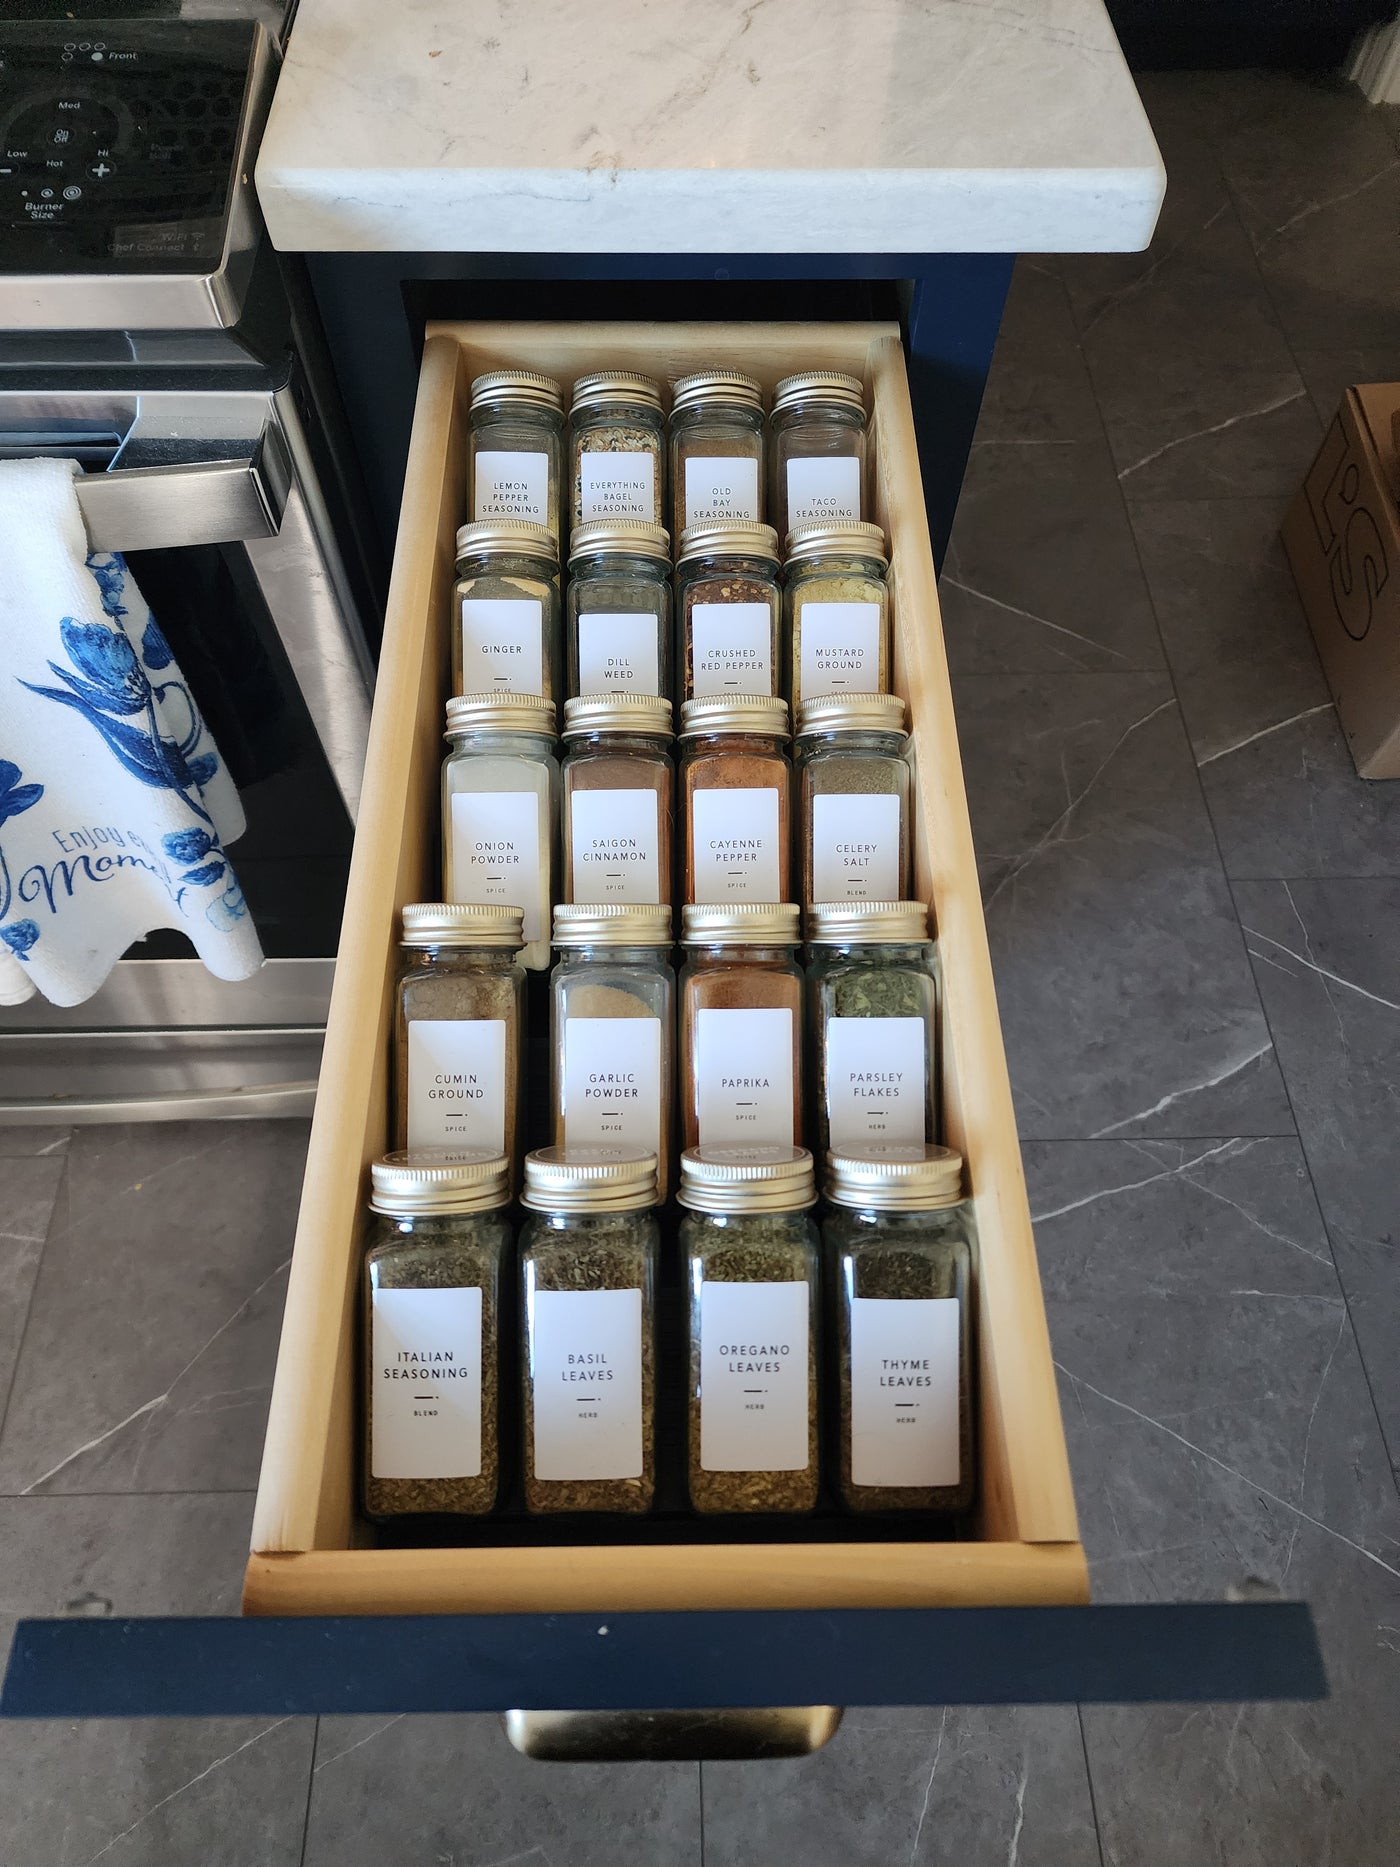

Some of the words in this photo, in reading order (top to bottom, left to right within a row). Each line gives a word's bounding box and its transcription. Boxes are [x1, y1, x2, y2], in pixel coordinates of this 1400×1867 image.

[108, 52, 137, 60] Front
[7, 150, 28, 158] Low
[98, 149, 109, 157] Hi
[24, 202, 64, 211] Burner
[30, 211, 54, 219] Size
[712, 487, 731, 495] OLD
[604, 493, 632, 502] BAGEL
[482, 504, 539, 513] SEASONING
[693, 510, 750, 518] SEASONING
[796, 509, 853, 518] SEASONING
[708, 649, 756, 658] CRUSHED
[52, 825, 126, 853] Enjoy
[593, 839, 635, 847] SAIGON
[476, 842, 513, 850] ONION
[710, 840, 762, 848] CAYENNE
[471, 856, 519, 864] POWDER
[583, 853, 645, 861] CINNAMON
[716, 853, 756, 861] PEPPER
[844, 858, 869, 866] SALT
[435, 1075, 476, 1083] CUMIN
[590, 1074, 634, 1082] GARLIC
[850, 1073, 902, 1082] PARSLEY
[722, 1079, 769, 1087] PAPRIKA
[429, 1090, 483, 1098] GROUND
[586, 1089, 638, 1097] POWDER
[854, 1088, 899, 1096] FLAKES
[720, 1345, 789, 1355] OREGANO
[398, 1352, 453, 1362] ITALIAN
[568, 1354, 607, 1364] BASIL
[729, 1362, 780, 1372] LEAVES
[882, 1360, 929, 1369] THYME
[384, 1368, 467, 1379] SEASONING
[562, 1370, 613, 1381] LEAVES
[880, 1377, 931, 1386] LEAVES
